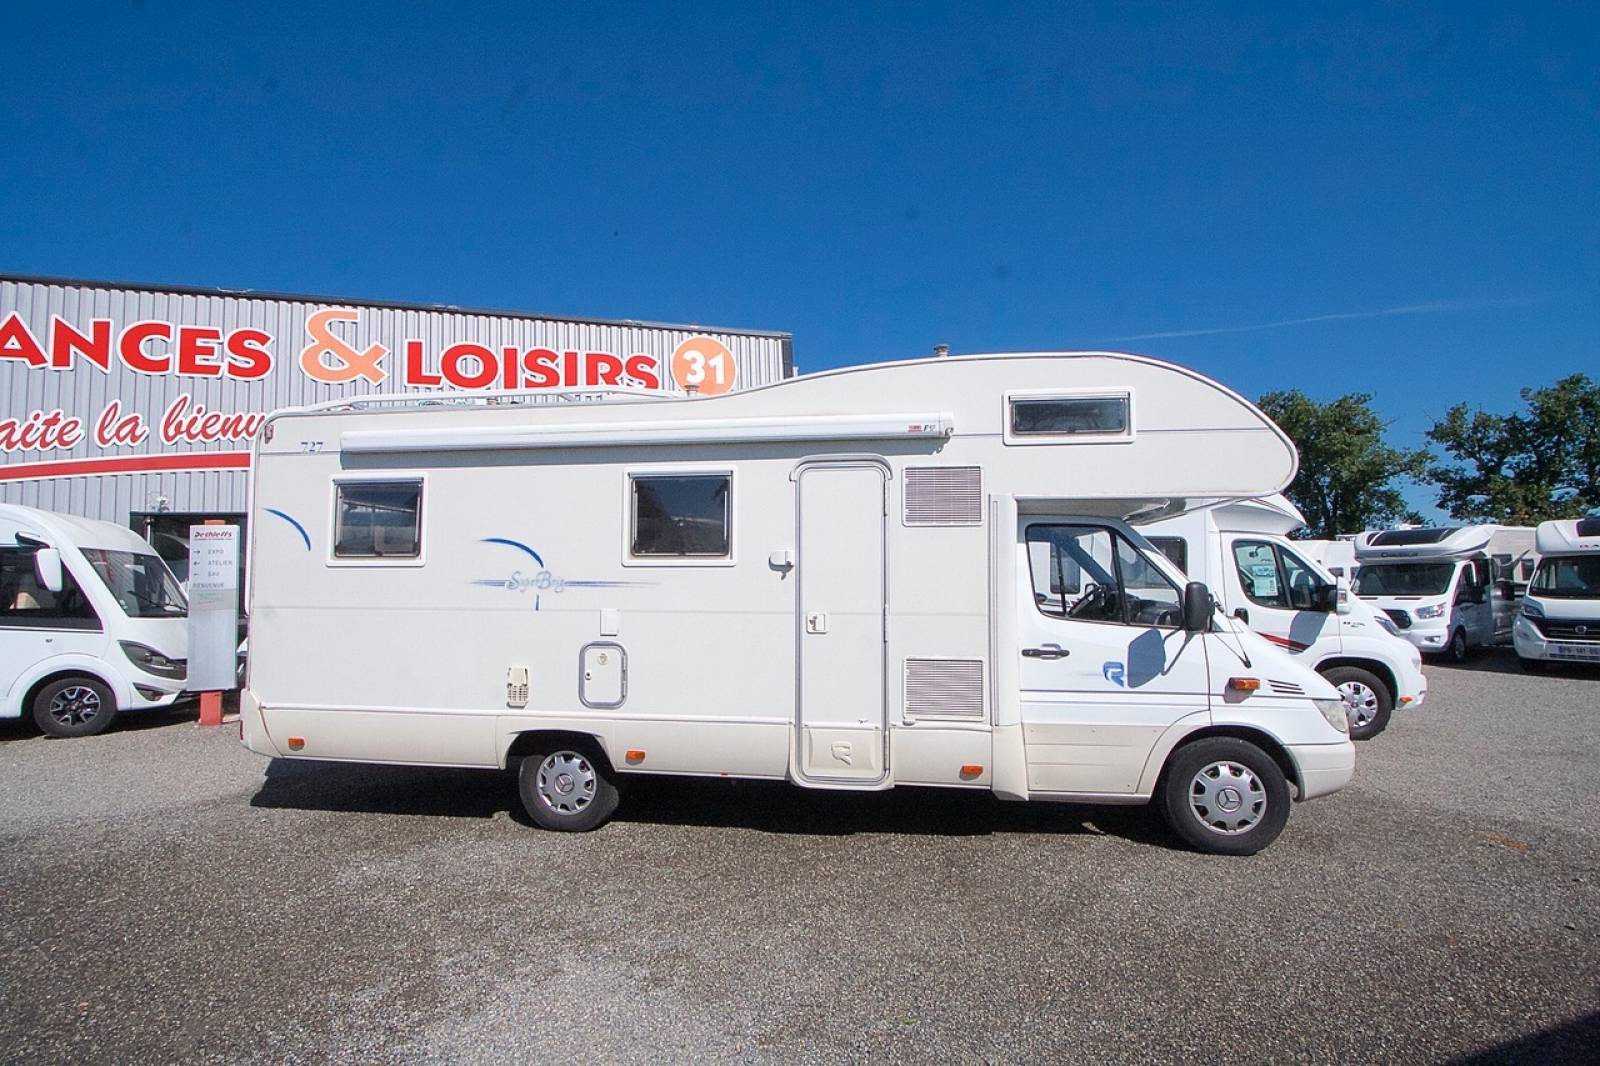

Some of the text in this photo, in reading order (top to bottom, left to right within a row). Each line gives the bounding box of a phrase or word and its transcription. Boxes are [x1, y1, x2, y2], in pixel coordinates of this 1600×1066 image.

[0, 310, 726, 390] ANCES & LOISIRS 31
[99, 402, 145, 445] la
[301, 441, 323, 455] 727
